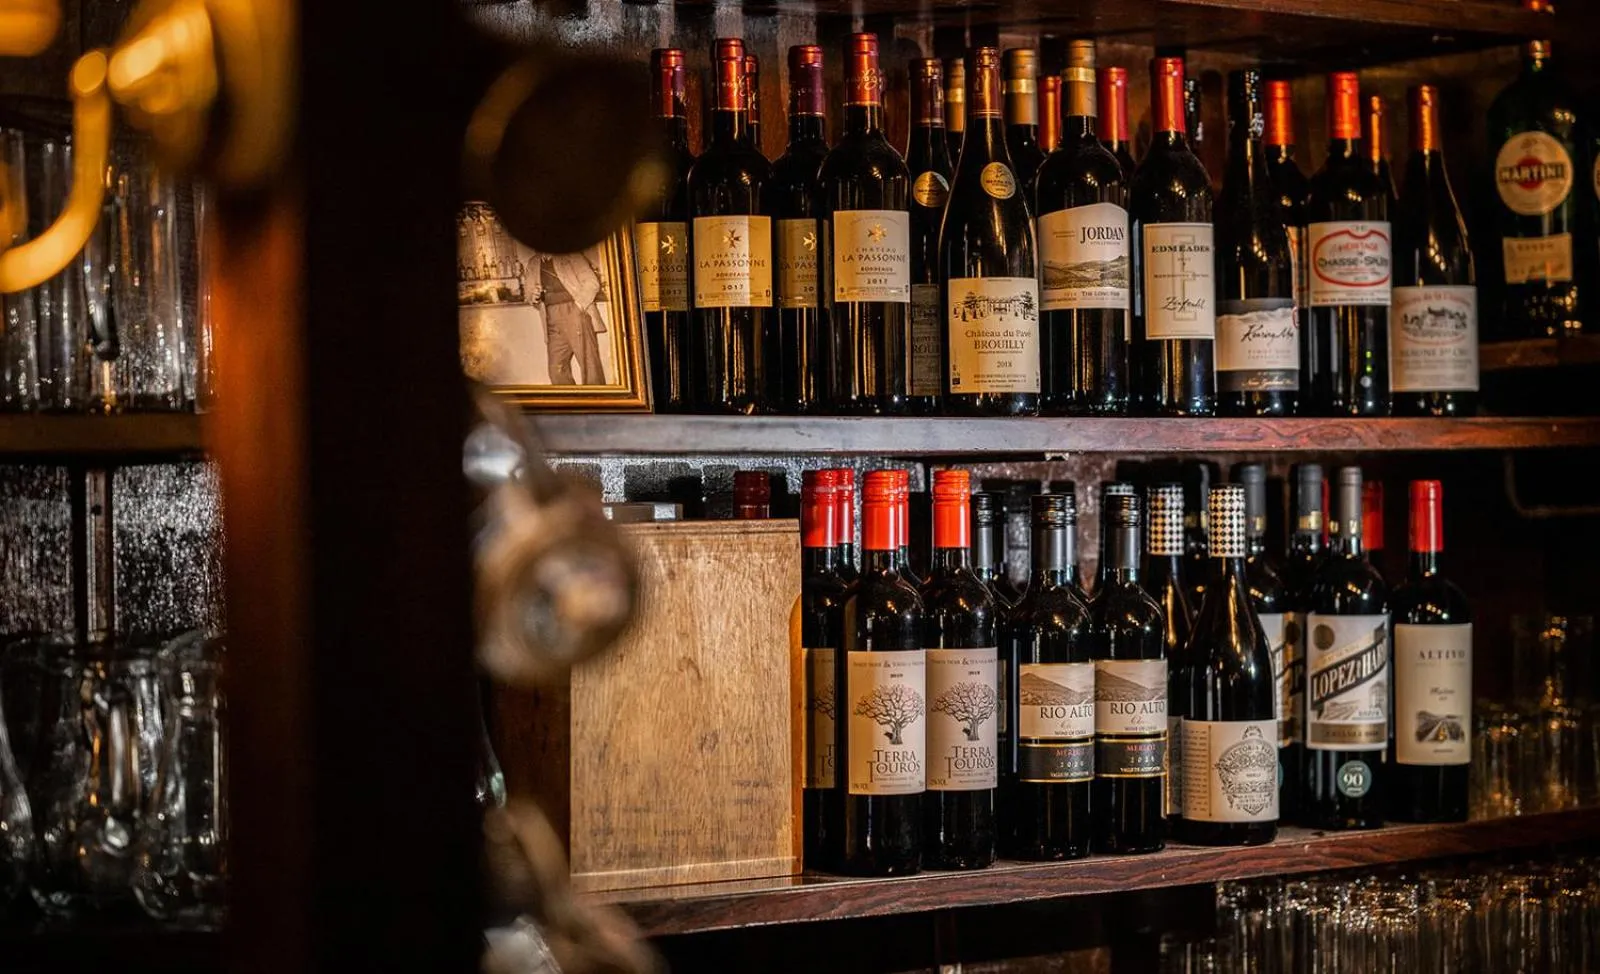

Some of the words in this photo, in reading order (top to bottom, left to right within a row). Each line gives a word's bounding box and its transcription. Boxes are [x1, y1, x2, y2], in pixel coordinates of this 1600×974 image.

[1501, 164, 1564, 182] MARTINI
[1080, 226, 1124, 244] JORDAN
[1152, 245, 1210, 253] EDMEADES
[700, 261, 711, 269] LA
[714, 259, 766, 268] PASSONNE
[842, 255, 855, 263] LA
[859, 254, 906, 263] PASSONNE
[652, 265, 687, 273] PASSO
[795, 261, 816, 269] PASS
[965, 329, 1001, 338] Château
[1003, 330, 1015, 338] du
[974, 339, 1026, 350] BROUILLY
[1419, 649, 1466, 659] ALTIVO
[1312, 659, 1357, 701] LOPEZ
[1040, 707, 1067, 719] RIO
[1070, 705, 1093, 718] ALTO
[1111, 703, 1136, 715] RIO
[1140, 701, 1165, 714] ALTO
[873, 749, 916, 762] TERRA
[952, 746, 991, 758] TERRA
[867, 761, 920, 783] TOUROS
[944, 756, 995, 778] TOUROS
[1344, 773, 1363, 786] 90
